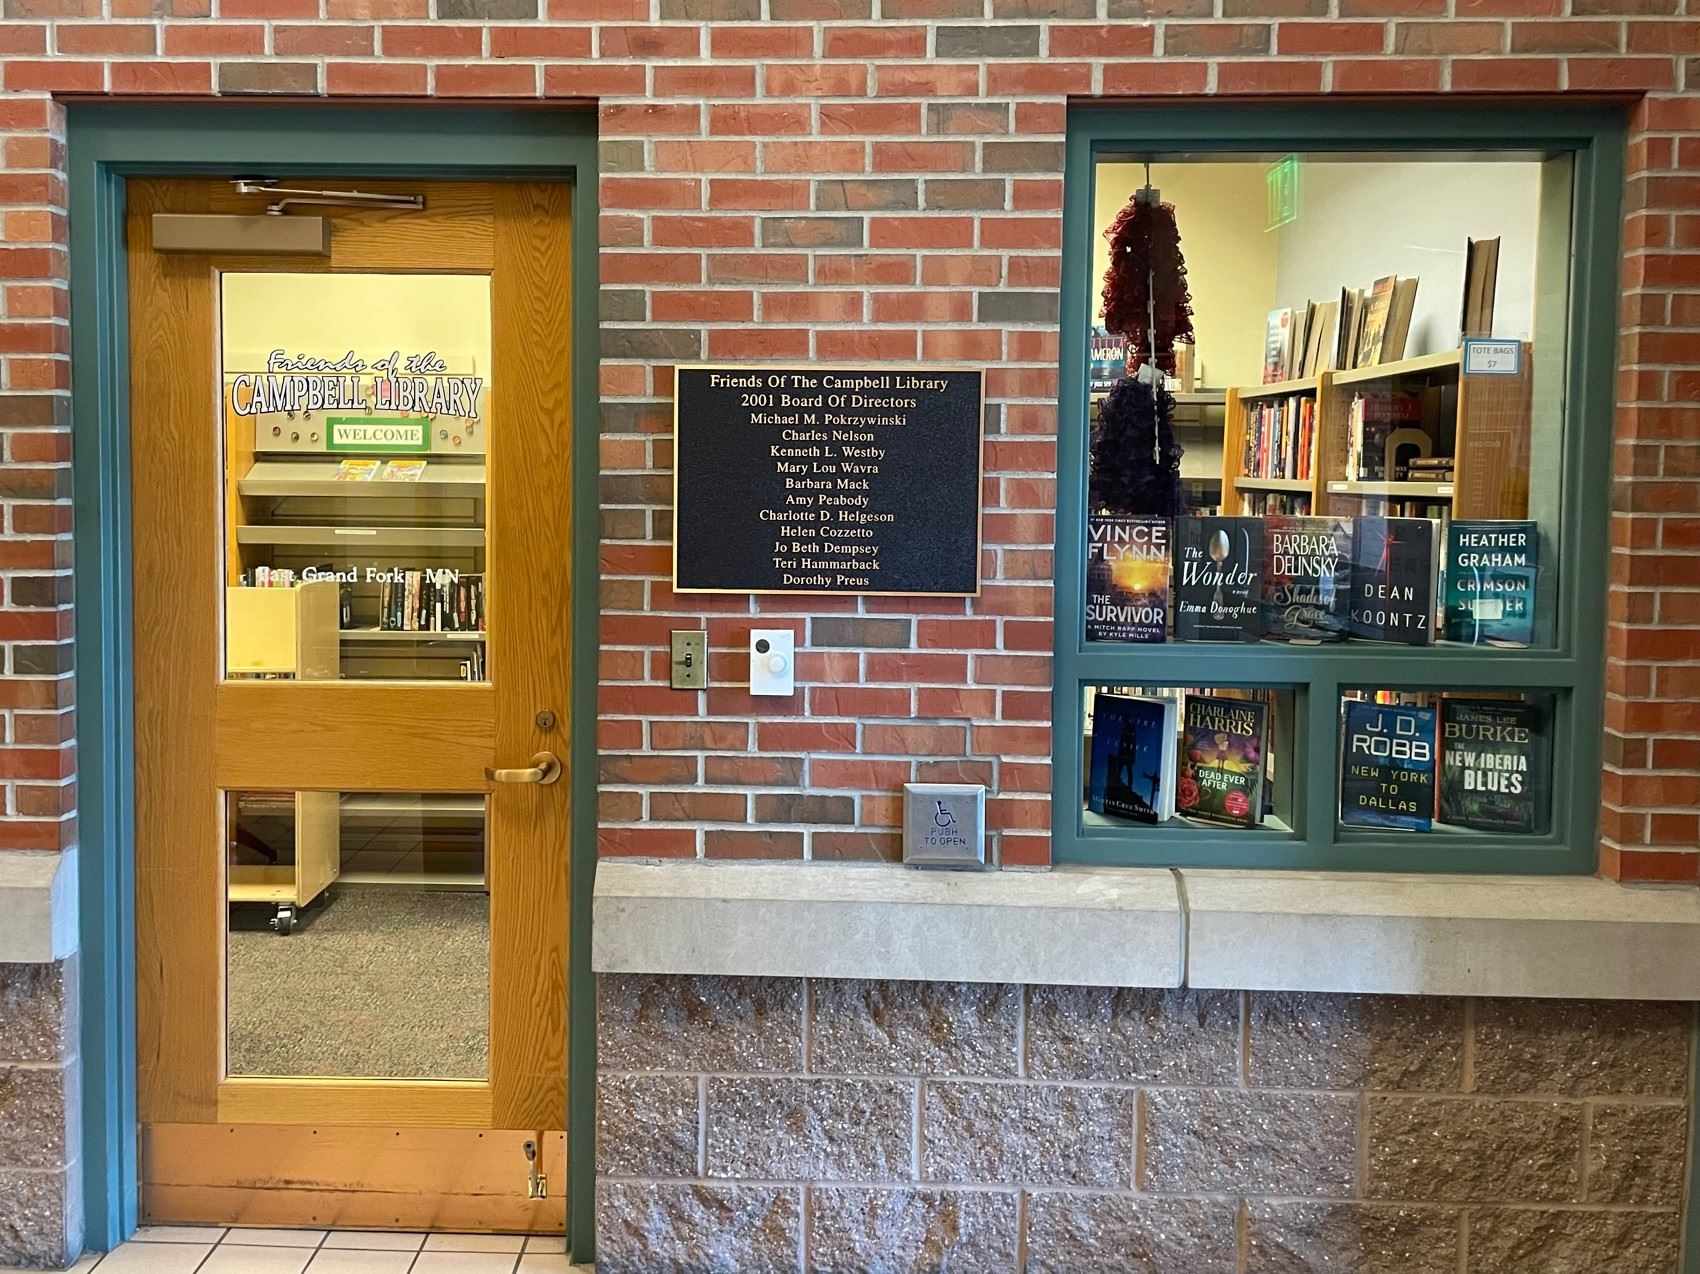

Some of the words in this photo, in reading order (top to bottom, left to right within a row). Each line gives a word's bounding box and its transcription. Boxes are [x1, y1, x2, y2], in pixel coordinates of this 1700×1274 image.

[267, 349, 367, 373] Friends
[371, 350, 399, 380] of
[405, 352, 447, 373] the
[710, 374, 762, 388] Friends
[768, 376, 786, 388] Of
[792, 376, 818, 388] The
[822, 376, 890, 391] Campbell
[896, 376, 948, 392] Library
[232, 374, 367, 416] CAMPBELL
[374, 376, 483, 418] LIBRARY
[741, 394, 774, 407] 2001
[780, 394, 822, 407] Board
[828, 395, 846, 408] Of
[851, 396, 916, 408] Directors
[750, 414, 799, 425] Michael
[804, 414, 820, 426] M.
[824, 414, 906, 428] Pokrzywinski
[337, 428, 419, 441] WELCOME
[782, 430, 828, 441] Charles
[832, 430, 874, 442] Nelson
[770, 446, 820, 457] Kenneth
[824, 446, 836, 457] L.
[842, 446, 886, 460] Westby
[776, 463, 808, 476] Mary
[813, 463, 836, 474] Lou
[841, 463, 878, 474] Wavra
[785, 478, 832, 490] Barbara
[836, 478, 870, 490] Mack
[786, 494, 814, 508] Amy
[818, 494, 869, 508] Peabody
[760, 510, 815, 522] Charlotte
[820, 510, 834, 522] D.
[838, 510, 894, 524] Helgeson
[780, 526, 816, 538] Helen
[820, 527, 873, 538] Cozzetto
[1088, 525, 1166, 543] VINCE
[1273, 534, 1338, 556] BARBARA
[1460, 534, 1526, 547] HEATHER
[774, 542, 787, 554] Jo
[792, 542, 819, 554] Beth
[824, 543, 878, 556] Dempsey
[1088, 543, 1165, 561] FLYNN
[1184, 547, 1204, 559] The
[773, 558, 796, 569] Teri
[802, 558, 880, 570] Hammarback
[1273, 555, 1338, 577] DELINSKY
[1458, 553, 1526, 567] GRAHAM
[302, 567, 358, 583] Grand
[426, 568, 459, 584] MN
[783, 574, 832, 587] Dorothy
[836, 575, 869, 586] Preus
[1182, 561, 1258, 586] Wonder
[1092, 595, 1111, 604] THE
[1364, 584, 1413, 601] DEAN
[1086, 604, 1163, 624] SURVIVOR
[1179, 601, 1207, 613] Emma
[1210, 602, 1257, 618] Donoghue
[1351, 608, 1426, 630] KOONTZ
[1189, 703, 1255, 723] CHARLAINE
[1456, 714, 1492, 723] JAMES
[1496, 716, 1517, 724] LEE
[1189, 714, 1253, 736] HARRIS
[1366, 713, 1387, 733] J.
[1396, 716, 1420, 737] D.
[1444, 722, 1529, 743] BURKE
[1352, 734, 1430, 762] ROBB
[1445, 750, 1476, 767] NEW
[1480, 753, 1527, 772] IBERIA
[1199, 769, 1221, 782] DEAD
[1223, 773, 1246, 786] EVER
[1351, 765, 1379, 778] NEW
[1391, 770, 1428, 784] YORK
[1464, 769, 1522, 794] BLUES
[1201, 778, 1227, 791] AFTER
[1380, 783, 1398, 795] TO
[1359, 796, 1417, 812] DALLAS
[930, 827, 958, 836] PUSH
[924, 837, 936, 845] TO
[939, 837, 966, 846] OPEN
